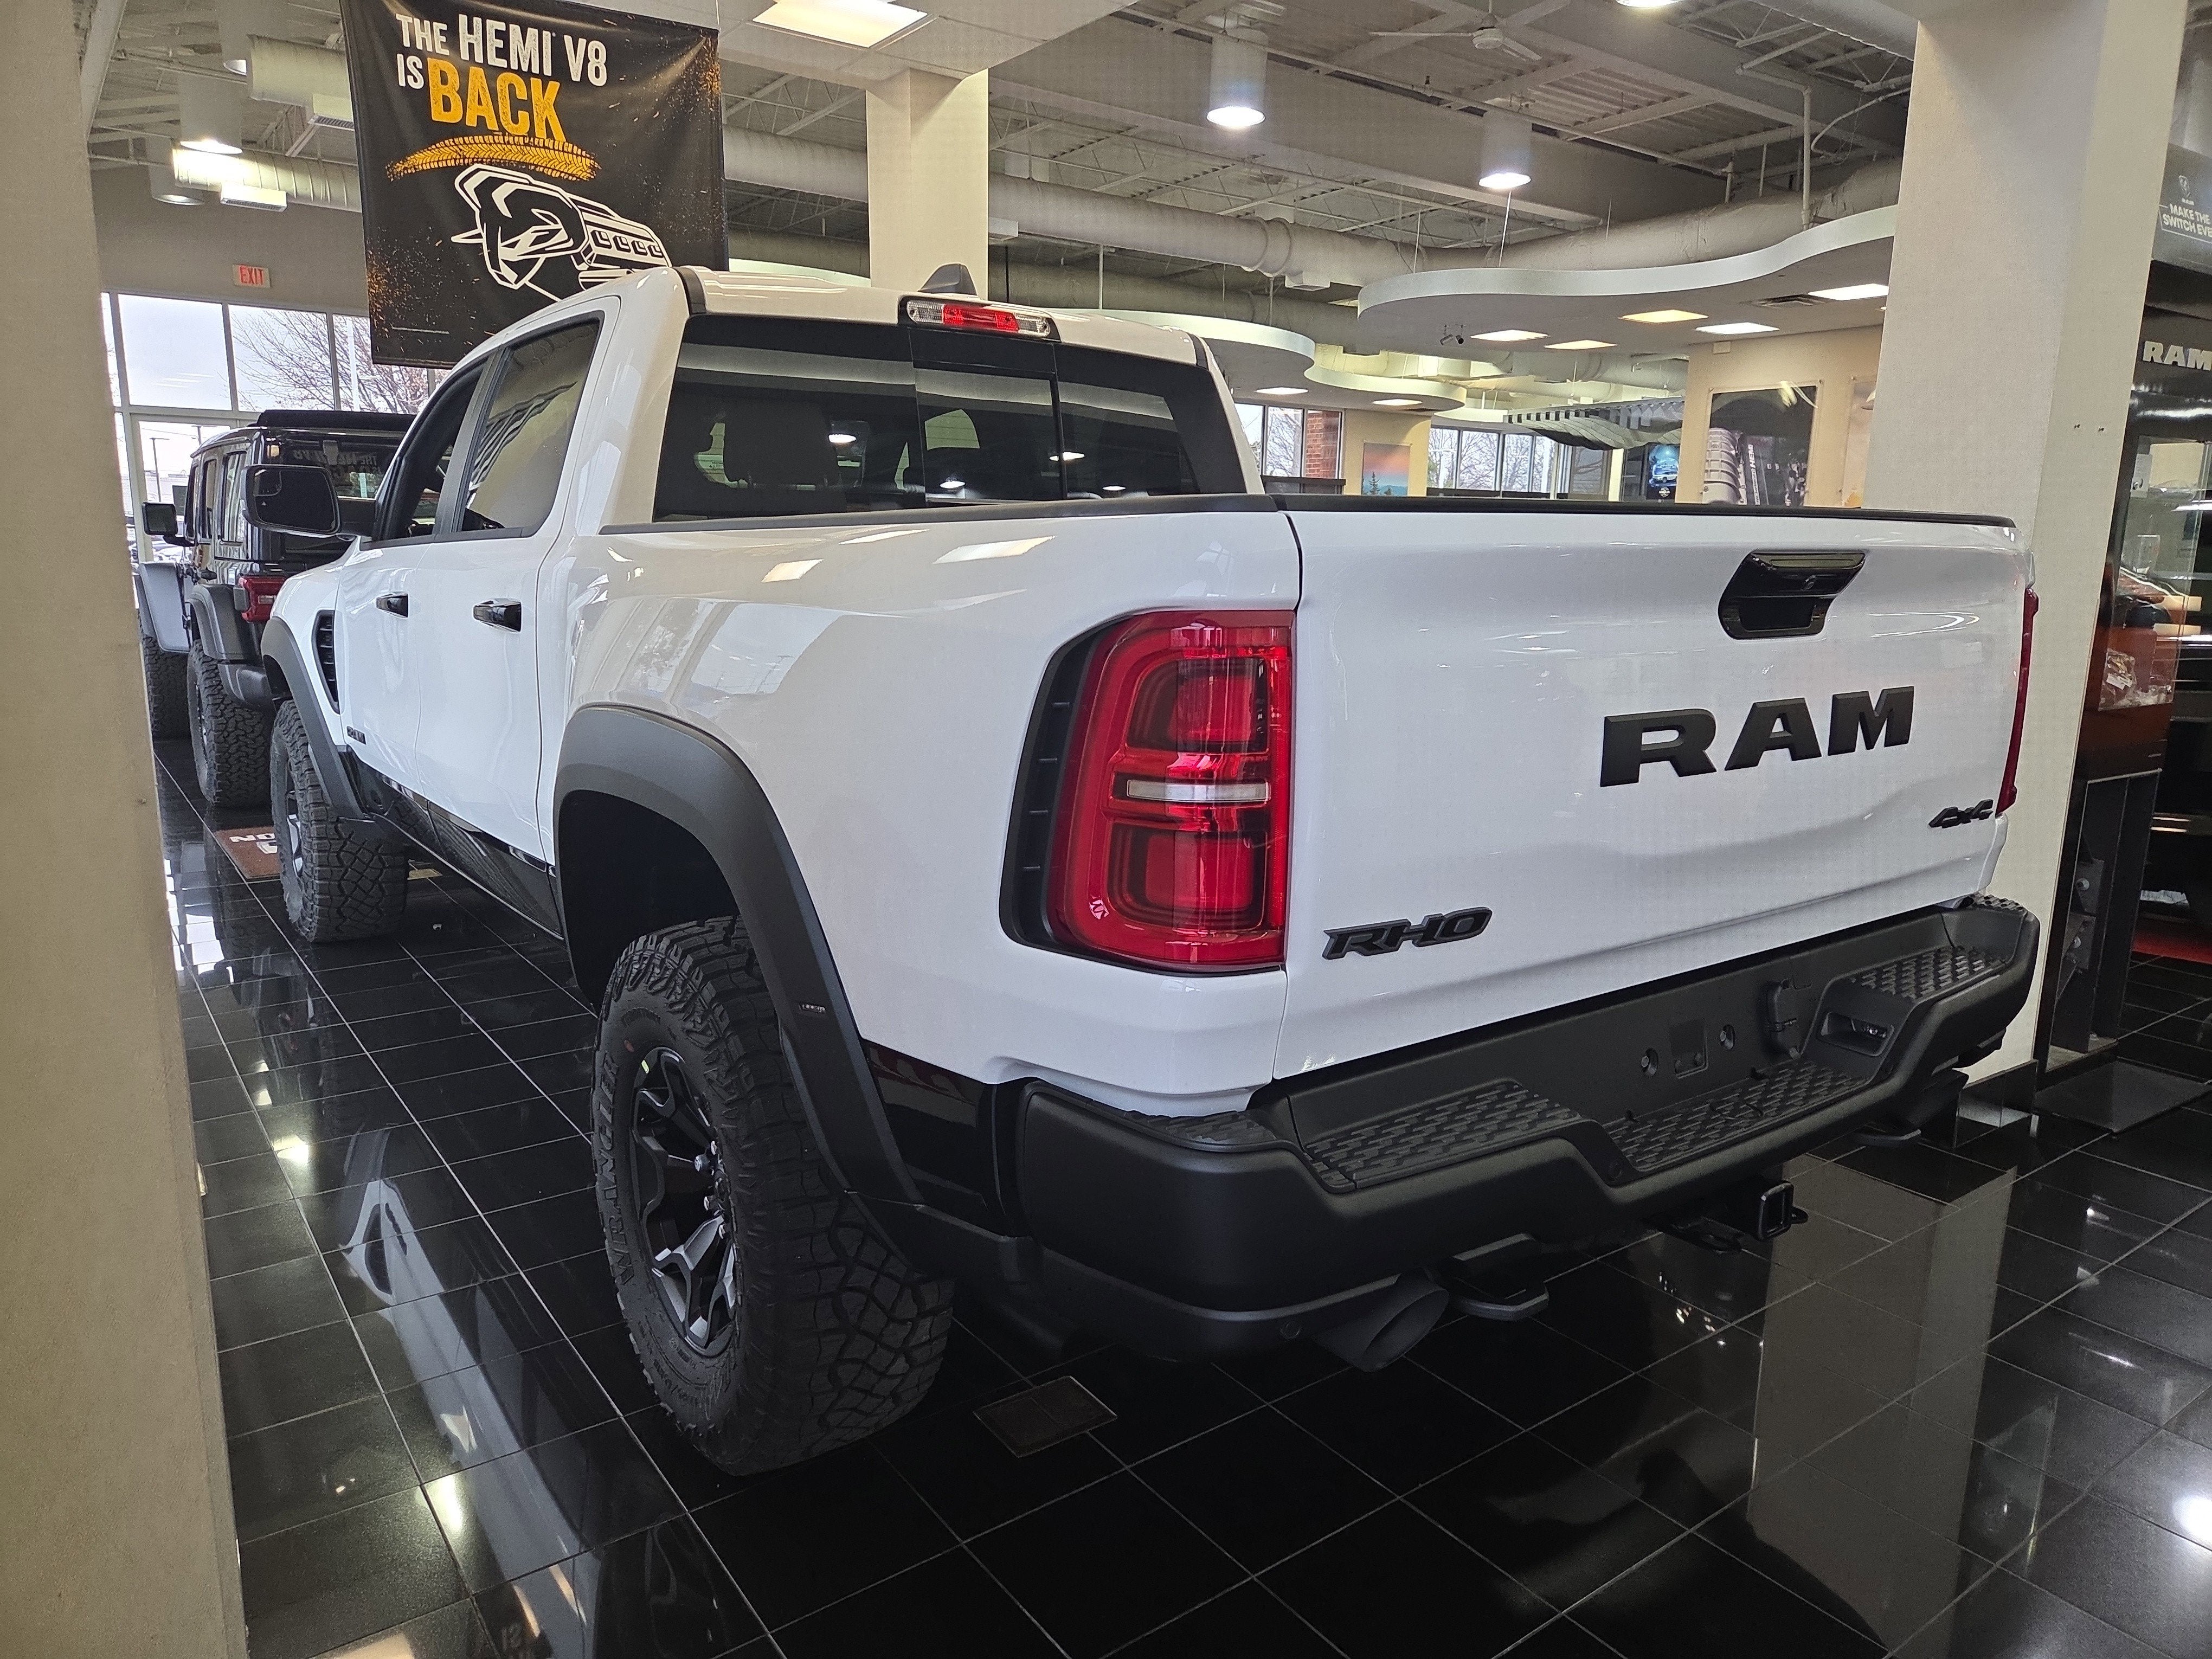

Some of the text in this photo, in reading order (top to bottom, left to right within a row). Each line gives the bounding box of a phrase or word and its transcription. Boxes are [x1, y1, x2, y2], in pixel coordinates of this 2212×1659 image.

[396, 14, 608, 87] THE HEMI V8
[396, 54, 567, 142] IS BACK
[2162, 213, 2196, 233] SWITCH
[2170, 203, 2211, 225] MAKE THE
[240, 266, 263, 285] EXIT
[2143, 340, 2212, 371] RAM
[1600, 686, 1914, 787] RAM
[1322, 906, 1493, 960] RHO
[595, 1050, 635, 1285] WRANGLER
